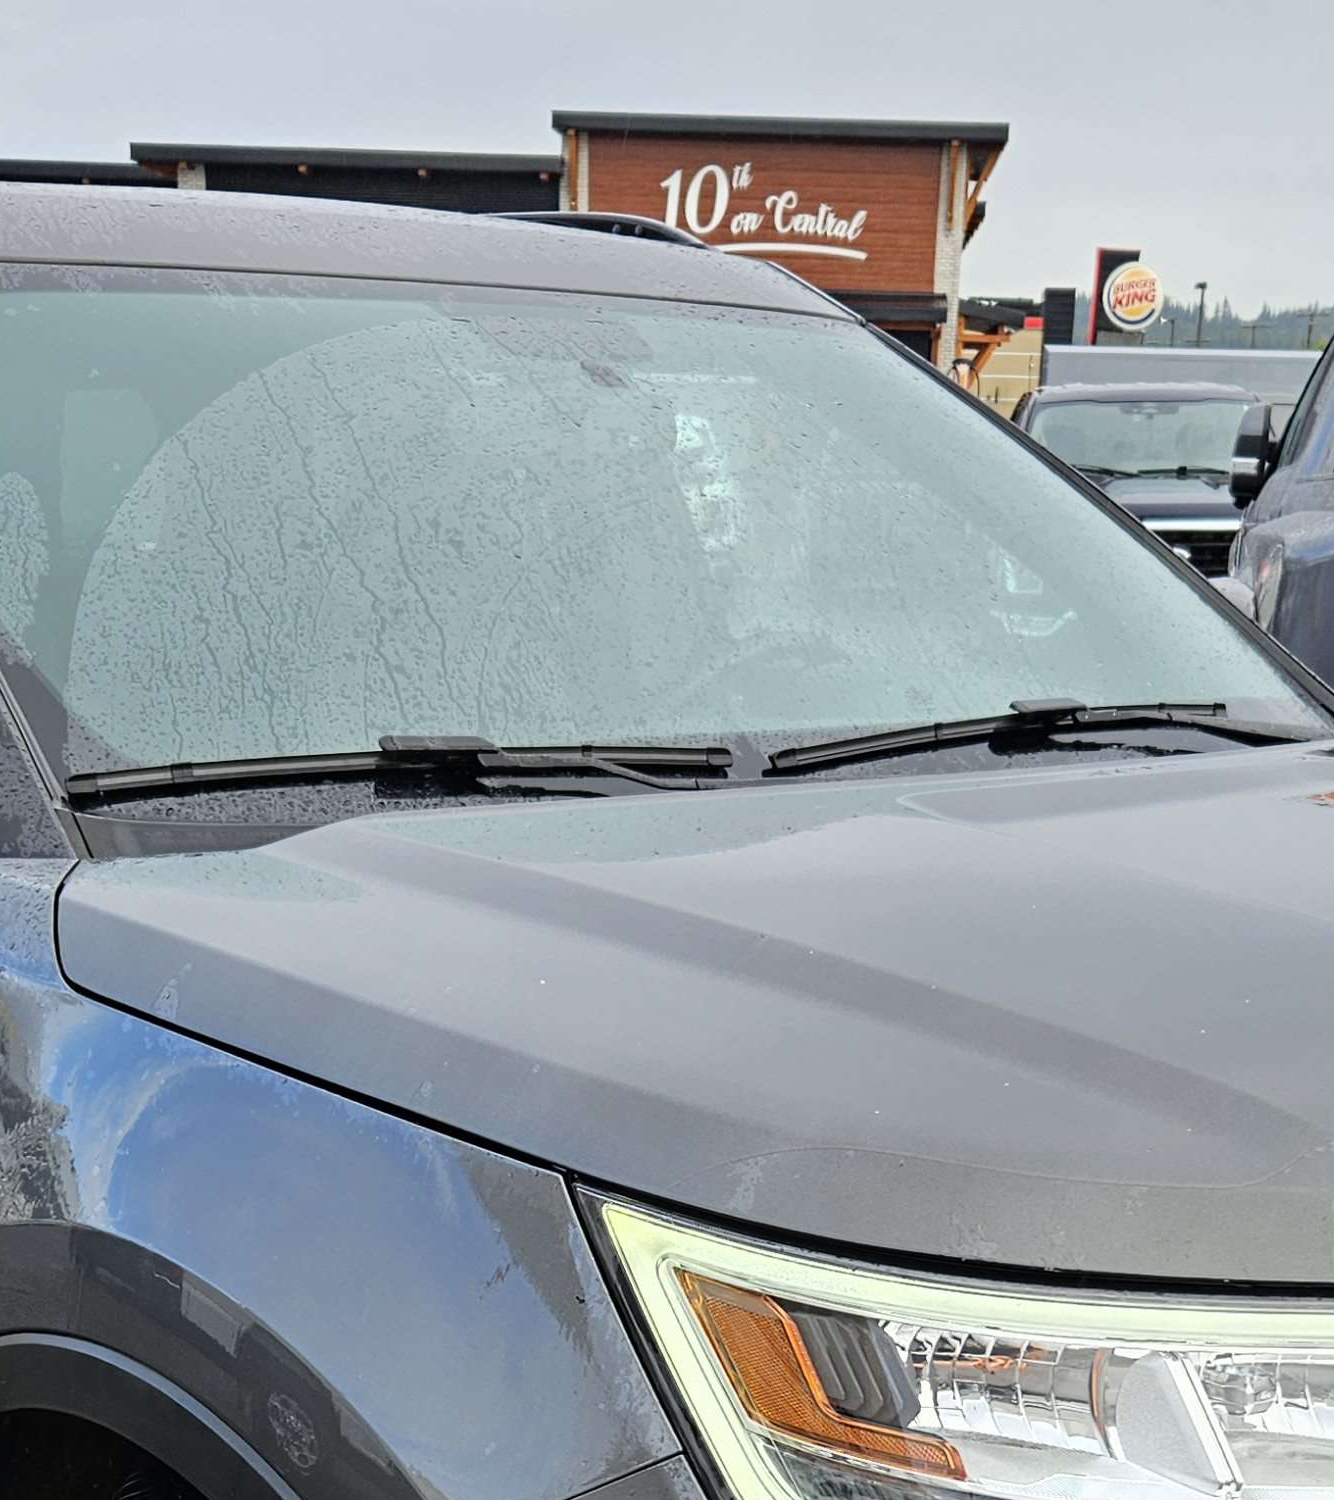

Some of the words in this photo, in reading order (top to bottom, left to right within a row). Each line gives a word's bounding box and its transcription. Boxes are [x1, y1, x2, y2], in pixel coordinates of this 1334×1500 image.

[730, 211, 765, 235] on
[766, 190, 867, 242] Central
[1114, 278, 1156, 294] BURGER
[1113, 288, 1156, 309] KING
